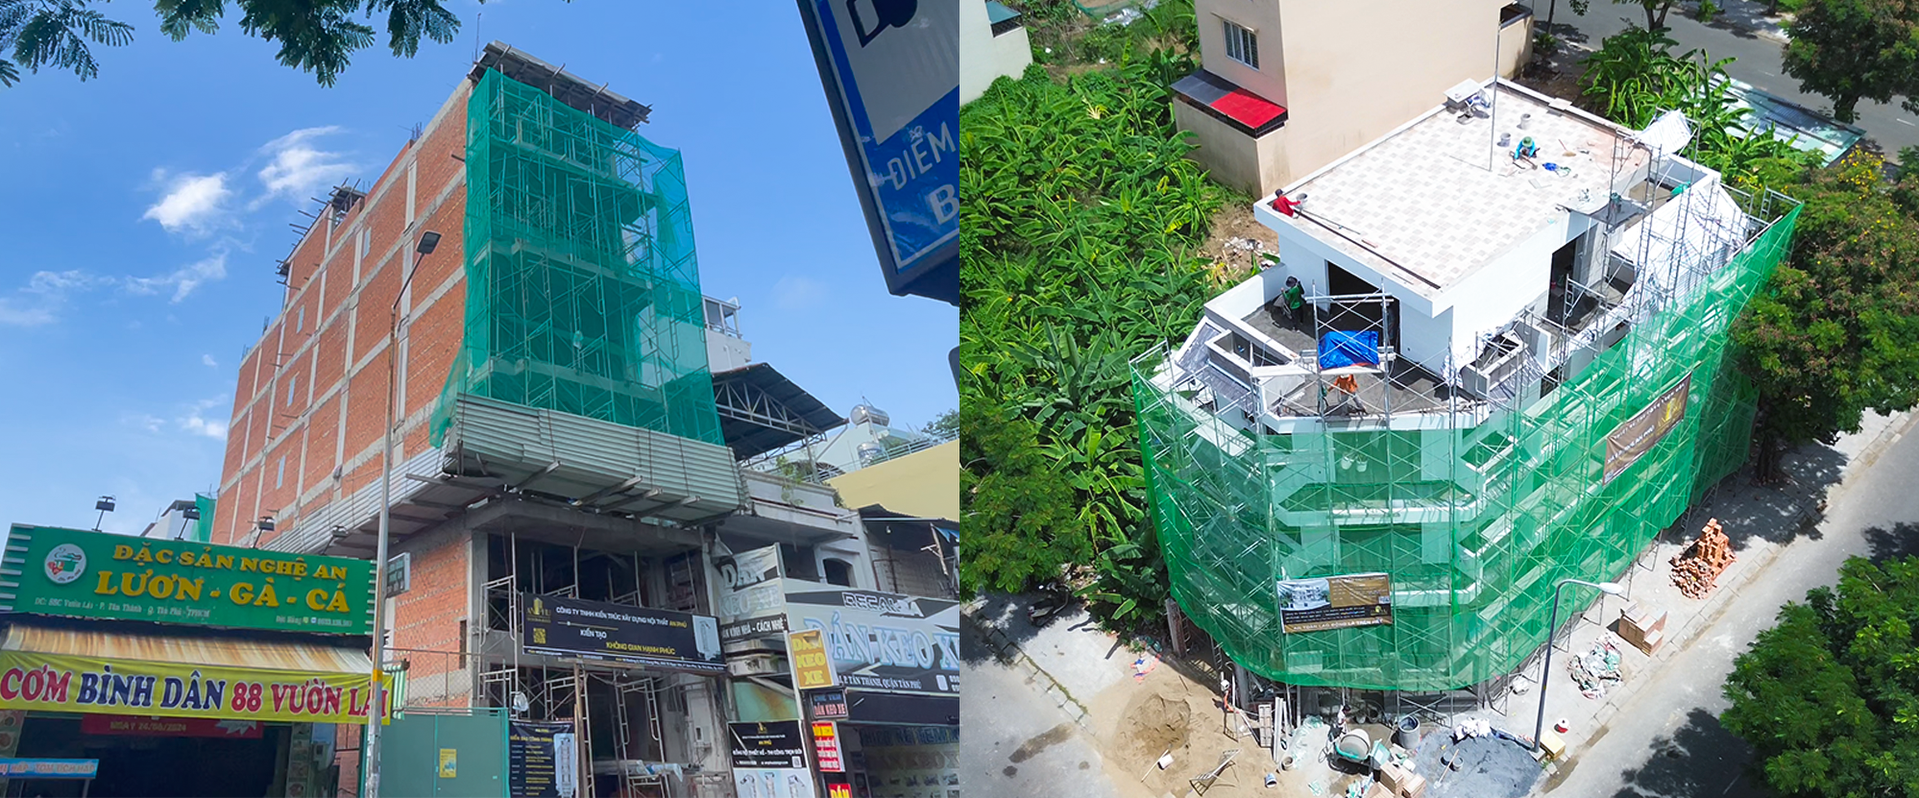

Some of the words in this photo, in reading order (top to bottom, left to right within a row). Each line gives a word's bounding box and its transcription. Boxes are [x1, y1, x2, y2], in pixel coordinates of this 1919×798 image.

[113, 542, 173, 566] ĐẶC
[178, 547, 234, 569] SẢN
[240, 557, 307, 581] NGHỆ
[313, 564, 347, 580] AN
[94, 569, 204, 601] LƯƠN
[229, 577, 279, 607] GÀ
[305, 582, 350, 613] CÁ
[756, 620, 771, 632] CÁCH
[796, 652, 826, 668] KEO
[873, 626, 934, 669] KEO
[0, 664, 72, 702] CƠM
[76, 663, 156, 707] BÌNH
[159, 669, 226, 710] DÂN
[231, 681, 262, 712] 88
[270, 677, 343, 715] VƯỜN
[804, 670, 825, 685] XE
